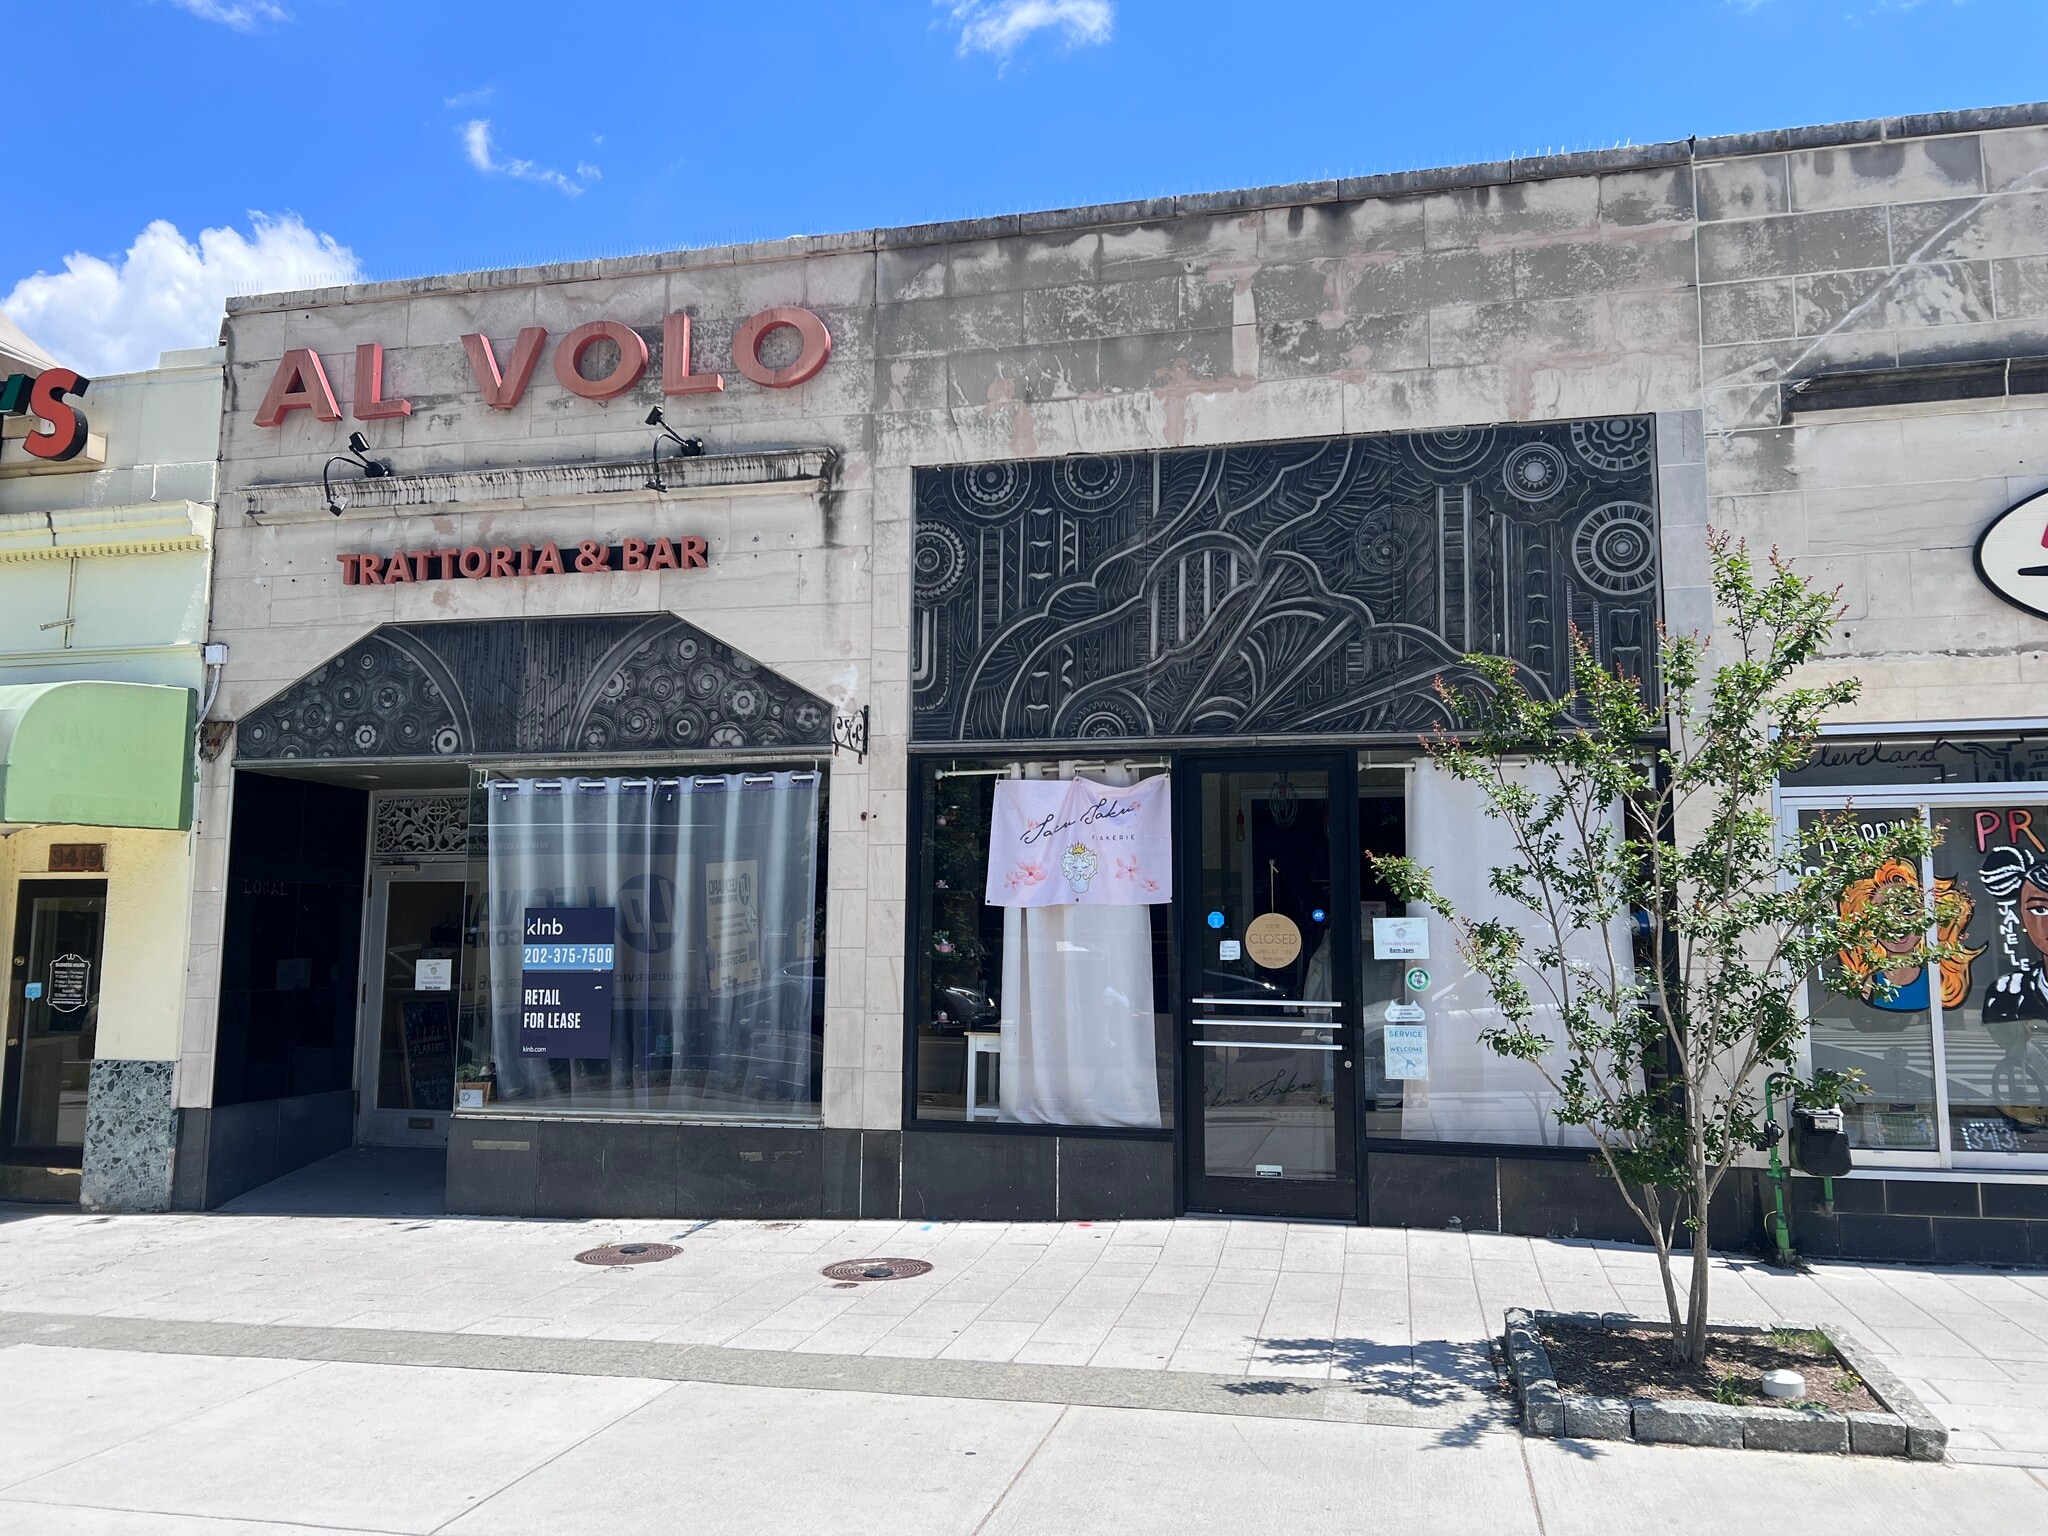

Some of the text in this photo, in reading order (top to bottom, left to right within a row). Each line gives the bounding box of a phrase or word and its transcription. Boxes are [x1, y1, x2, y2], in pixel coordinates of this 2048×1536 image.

[253, 306, 832, 427] AL VOLO
[337, 535, 709, 587] TRATTORIA & BAR
[526, 917, 564, 936] klnb
[1249, 933, 1298, 945] CLOSED
[1997, 899, 2031, 972] JANELLE
[524, 947, 613, 964] 202-375-7500
[524, 989, 561, 1006] RETAIL
[523, 1012, 582, 1029] FOR LEASE
[1388, 1030, 1423, 1038] SERVICE
[522, 1045, 547, 1053] klnb.com
